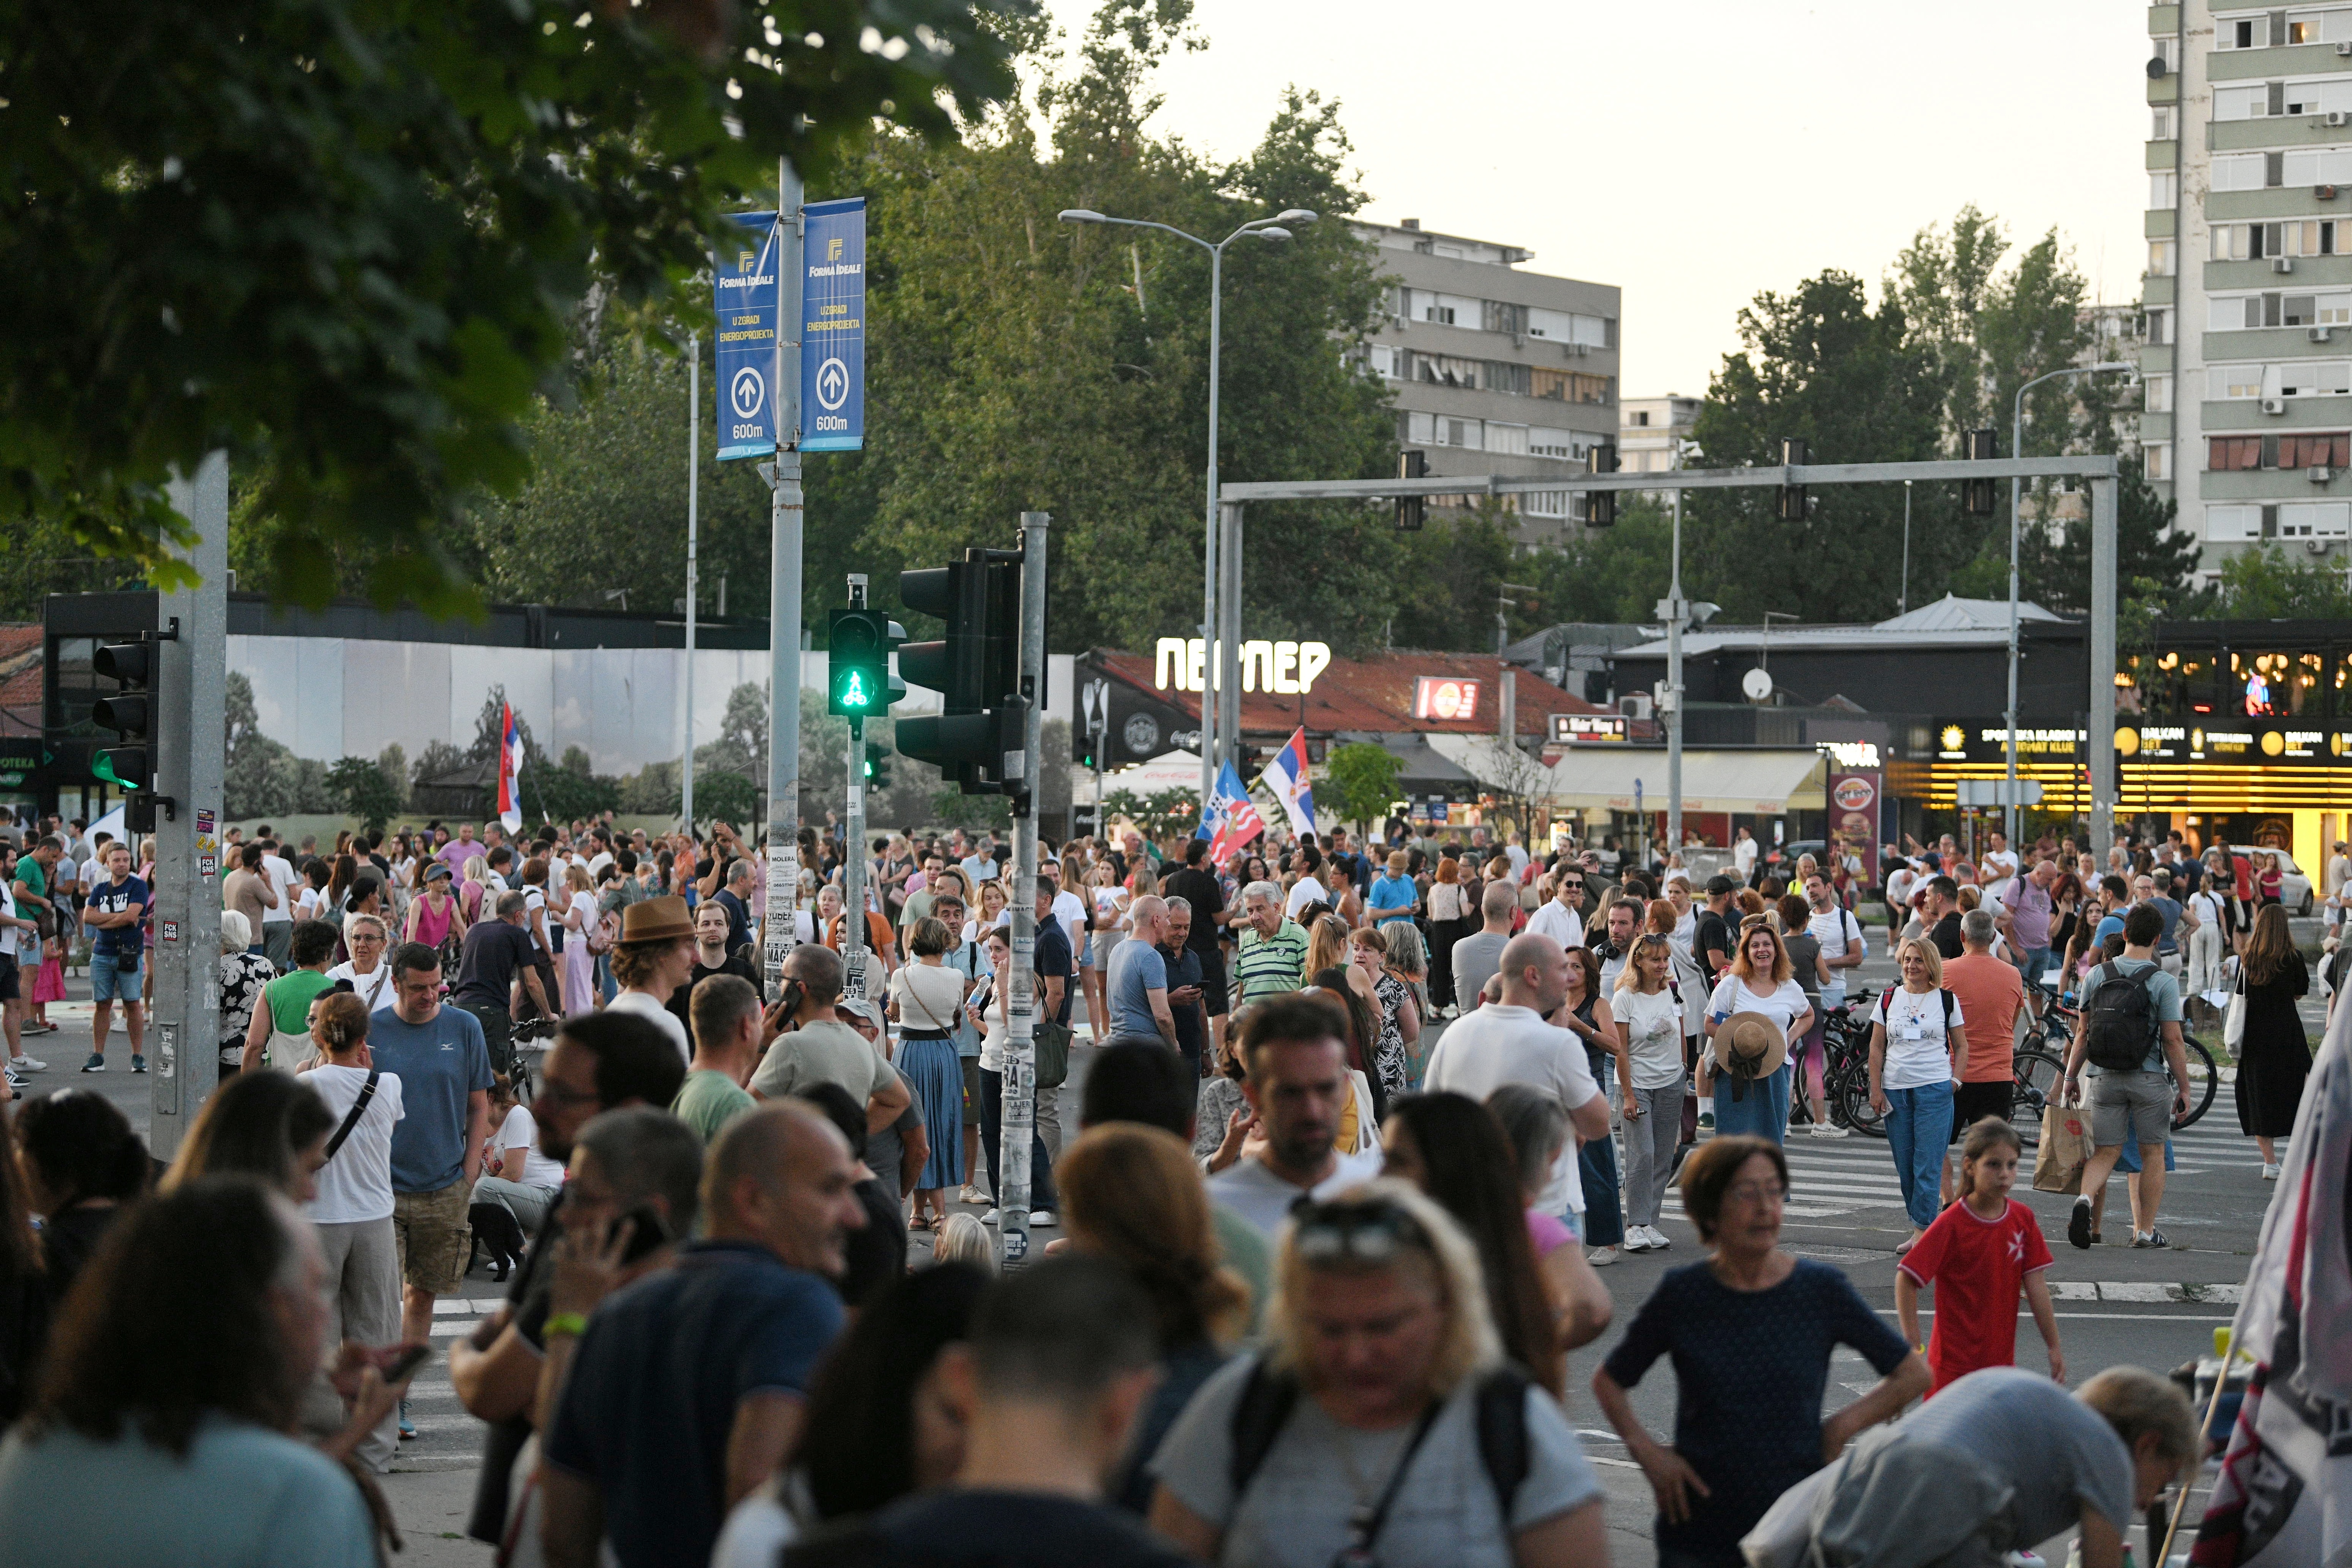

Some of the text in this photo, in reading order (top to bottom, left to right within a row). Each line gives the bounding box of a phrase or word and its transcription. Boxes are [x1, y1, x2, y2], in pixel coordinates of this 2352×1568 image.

[820, 305, 847, 315] U ZGRADI
[733, 315, 760, 326] U ZGRADI
[807, 319, 860, 332] ENERGOPROJEKTA
[720, 329, 774, 342] ENERGOPROJEKTA
[817, 416, 847, 431] 600m
[733, 424, 763, 439] 600m
